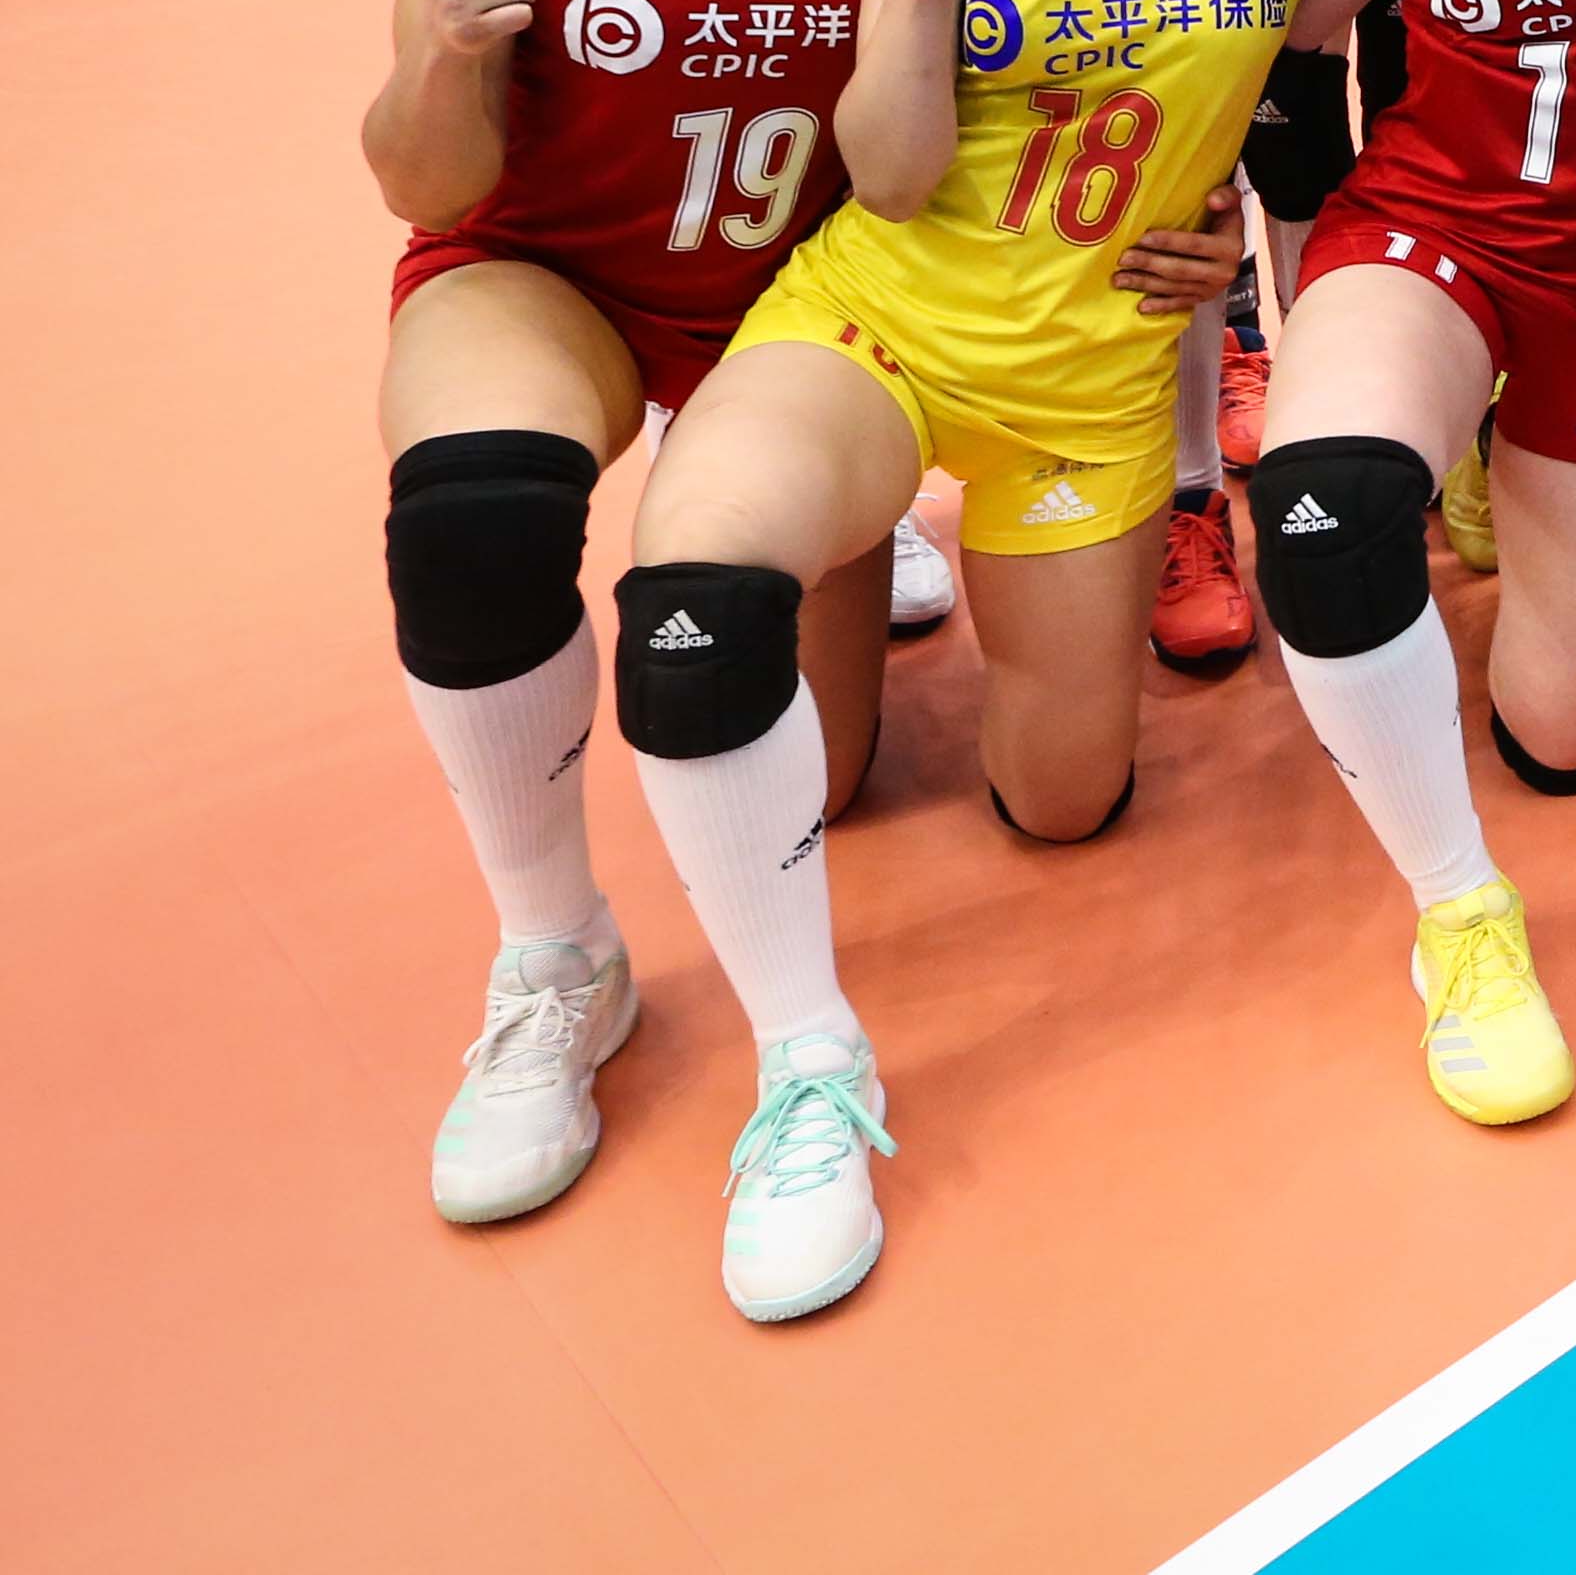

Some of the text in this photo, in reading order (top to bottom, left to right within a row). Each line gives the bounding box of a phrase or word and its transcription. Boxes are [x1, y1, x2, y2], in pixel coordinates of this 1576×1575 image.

[684, 3, 851, 49] 太平洋
[681, 52, 789, 79] CPIC
[1045, 43, 1145, 75] CPIC
[667, 107, 820, 252] 19
[996, 86, 1163, 246] 18
[1022, 503, 1096, 524] adidas
[1281, 517, 1339, 535] adidas
[649, 634, 714, 650] adidas
